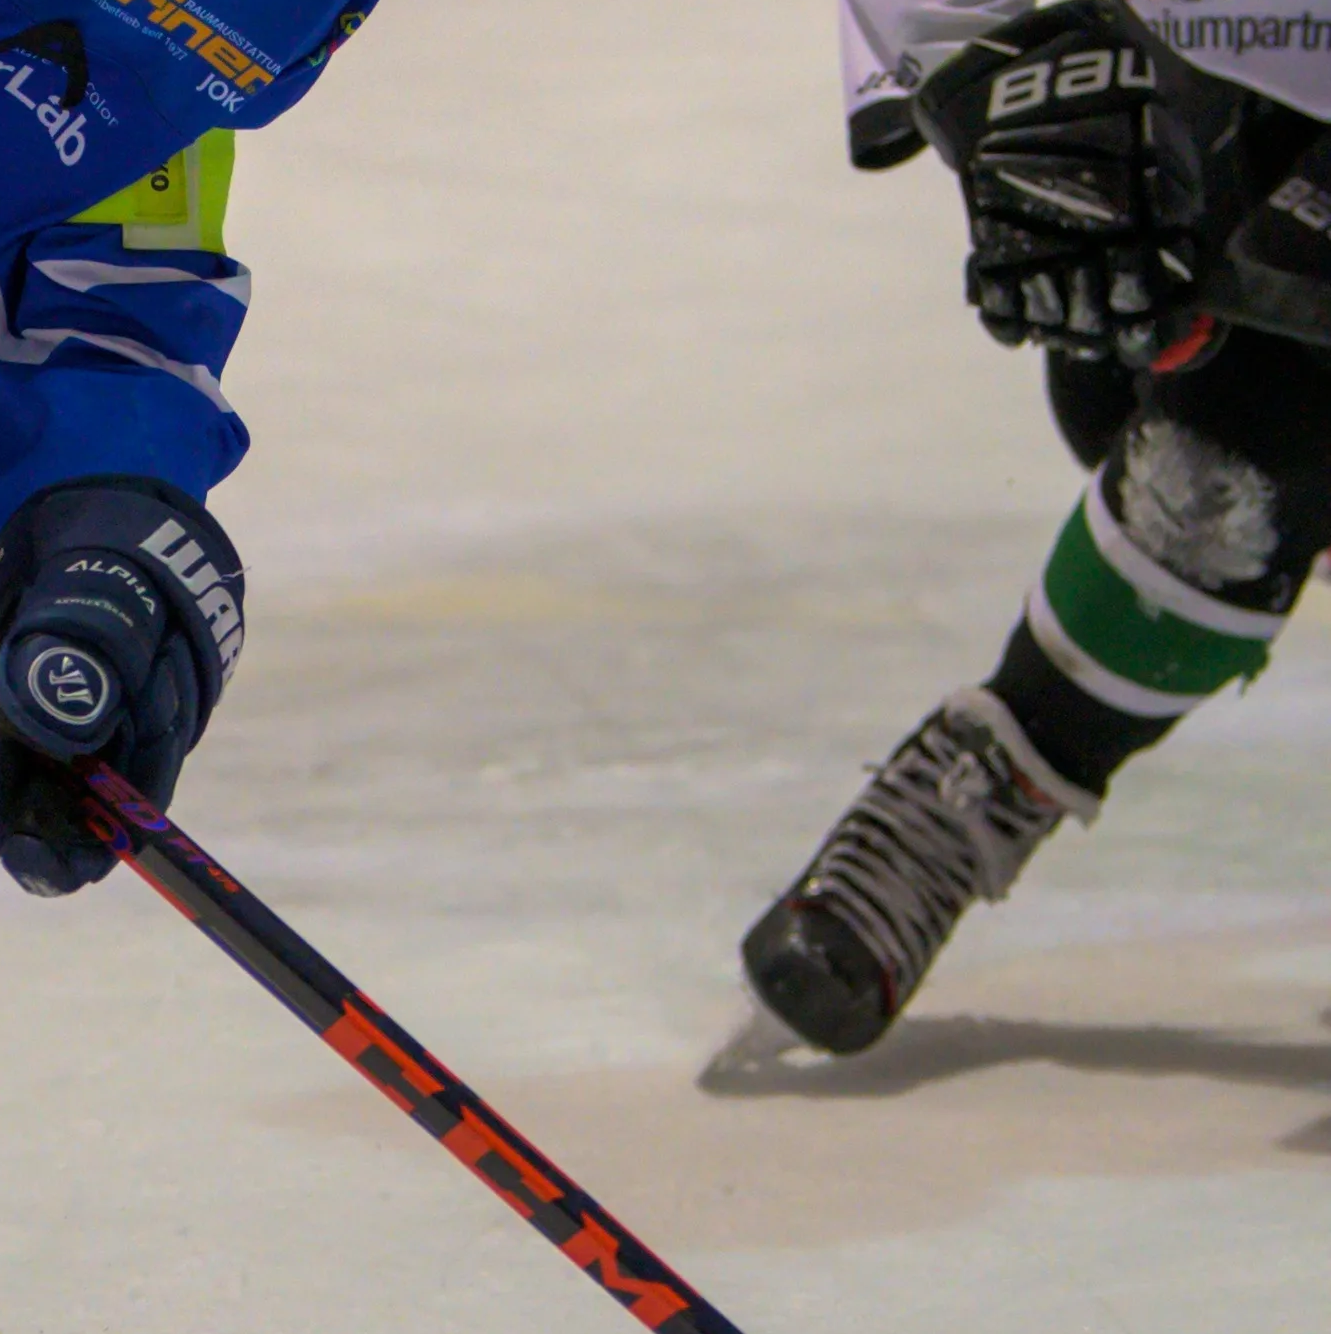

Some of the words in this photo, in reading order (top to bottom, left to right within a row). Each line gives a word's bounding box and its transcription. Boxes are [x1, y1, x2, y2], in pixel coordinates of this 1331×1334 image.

[164, 36, 189, 62] 1977
[195, 72, 246, 115] JOK
[64, 558, 156, 616] ALPHA
[322, 998, 690, 1330] CCM
